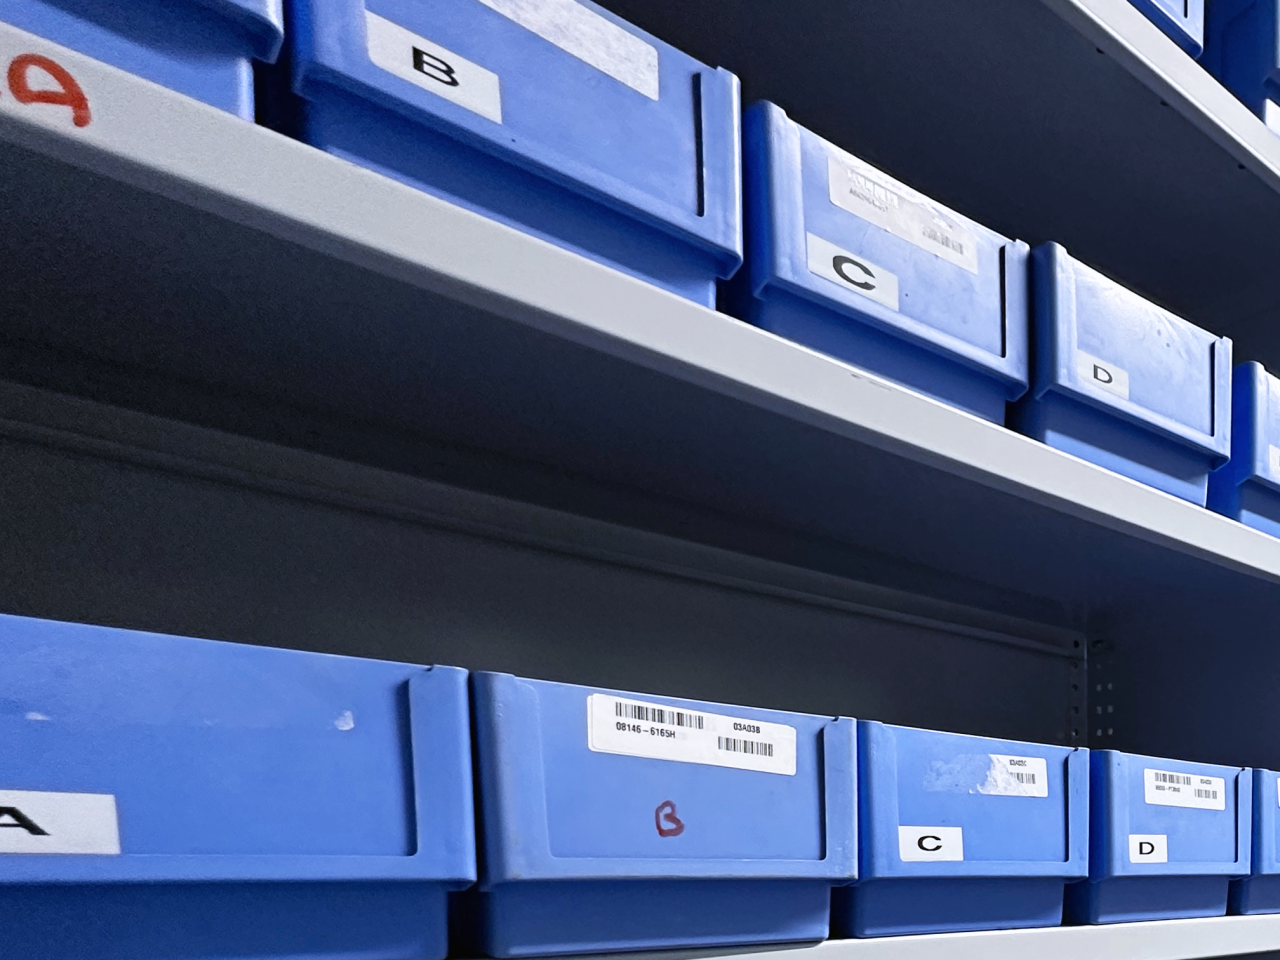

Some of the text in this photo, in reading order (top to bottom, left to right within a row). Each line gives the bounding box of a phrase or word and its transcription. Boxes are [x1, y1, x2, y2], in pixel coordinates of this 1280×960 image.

[411, 46, 460, 87] B
[7, 53, 91, 128] A
[832, 254, 876, 292] C
[1092, 364, 1113, 385] D
[654, 800, 685, 838] B
[917, 835, 943, 853] C
[1138, 841, 1155, 855] D
